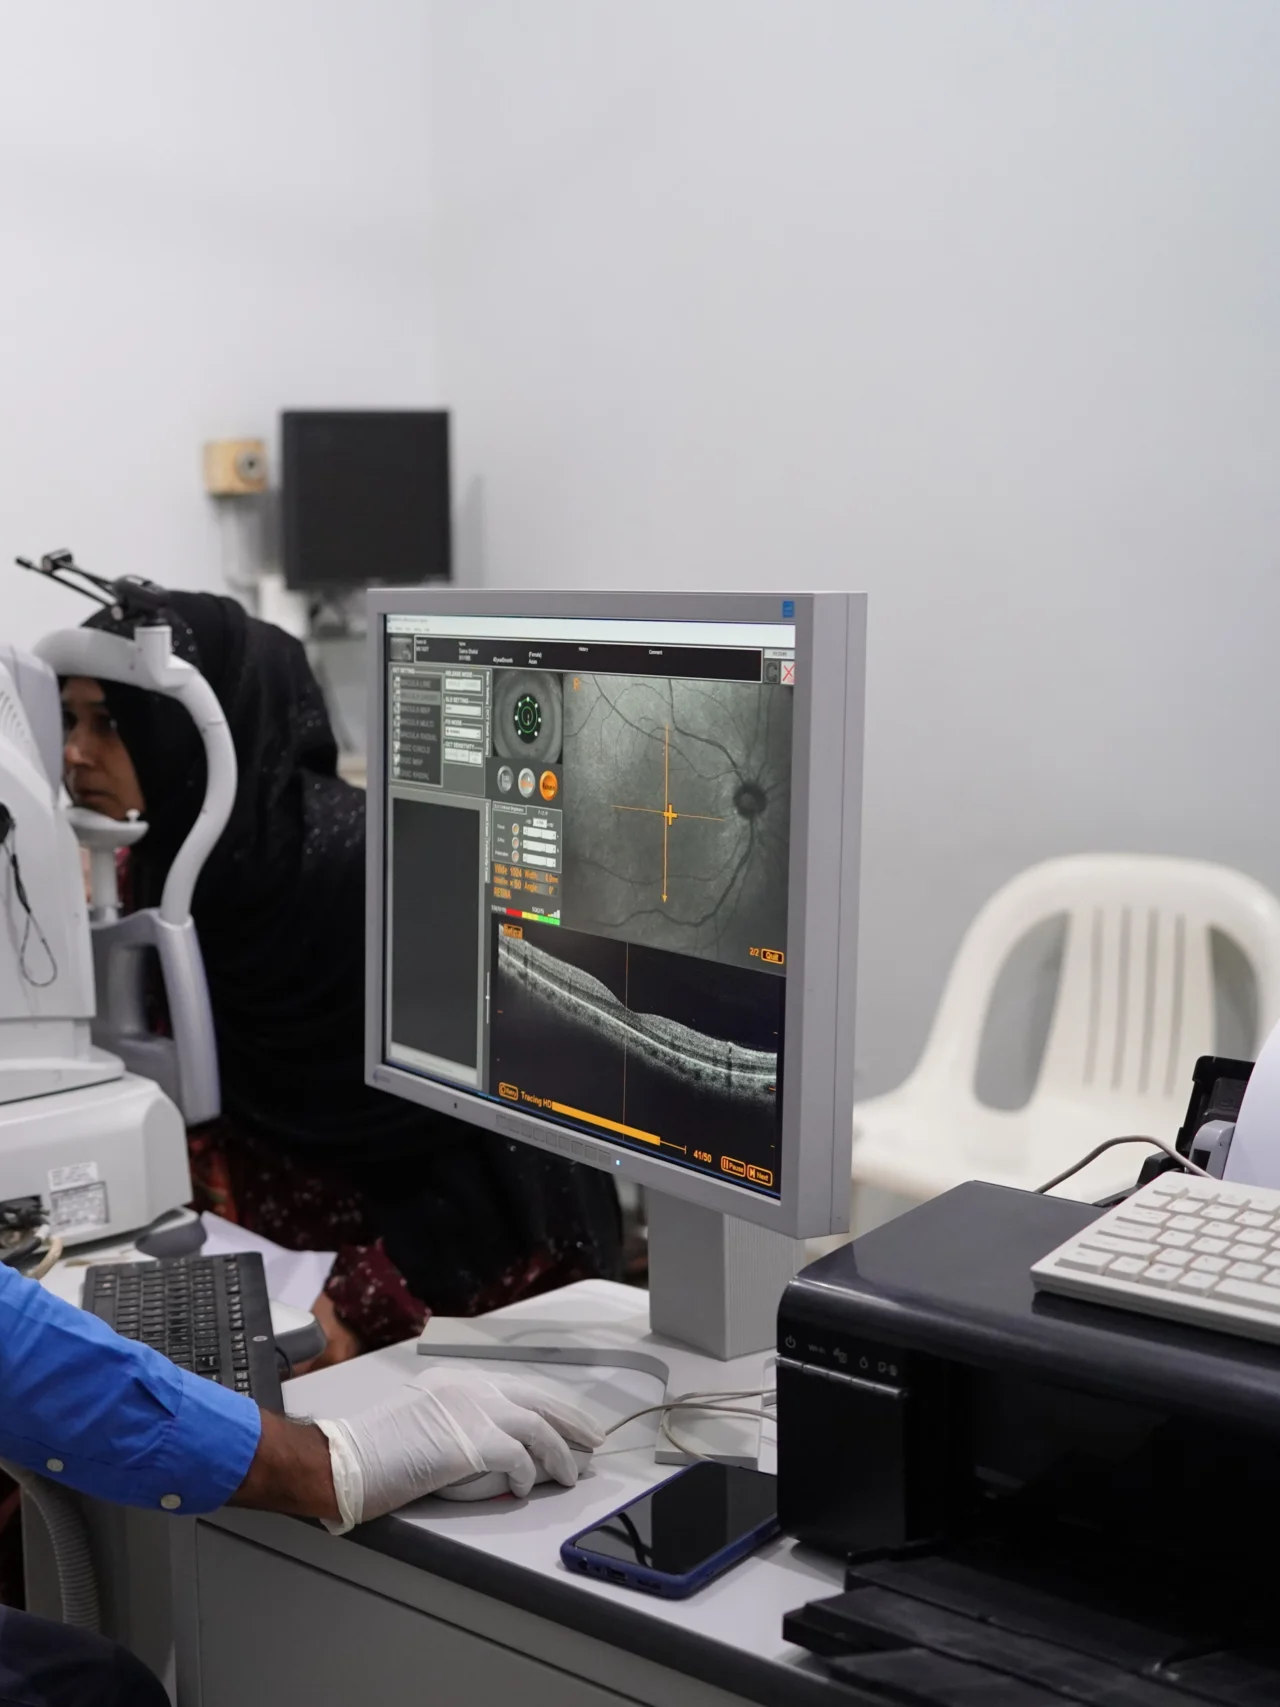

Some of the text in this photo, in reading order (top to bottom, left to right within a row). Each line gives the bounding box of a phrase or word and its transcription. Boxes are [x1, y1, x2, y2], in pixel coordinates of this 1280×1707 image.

[572, 677, 580, 691] R
[493, 886, 511, 900] RETINA
[765, 951, 779, 962] Quit
[520, 1090, 552, 1109] Tracing HD
[693, 1149, 712, 1164] 41/50
[728, 1162, 744, 1174] Pause
[756, 1171, 769, 1182] Next
